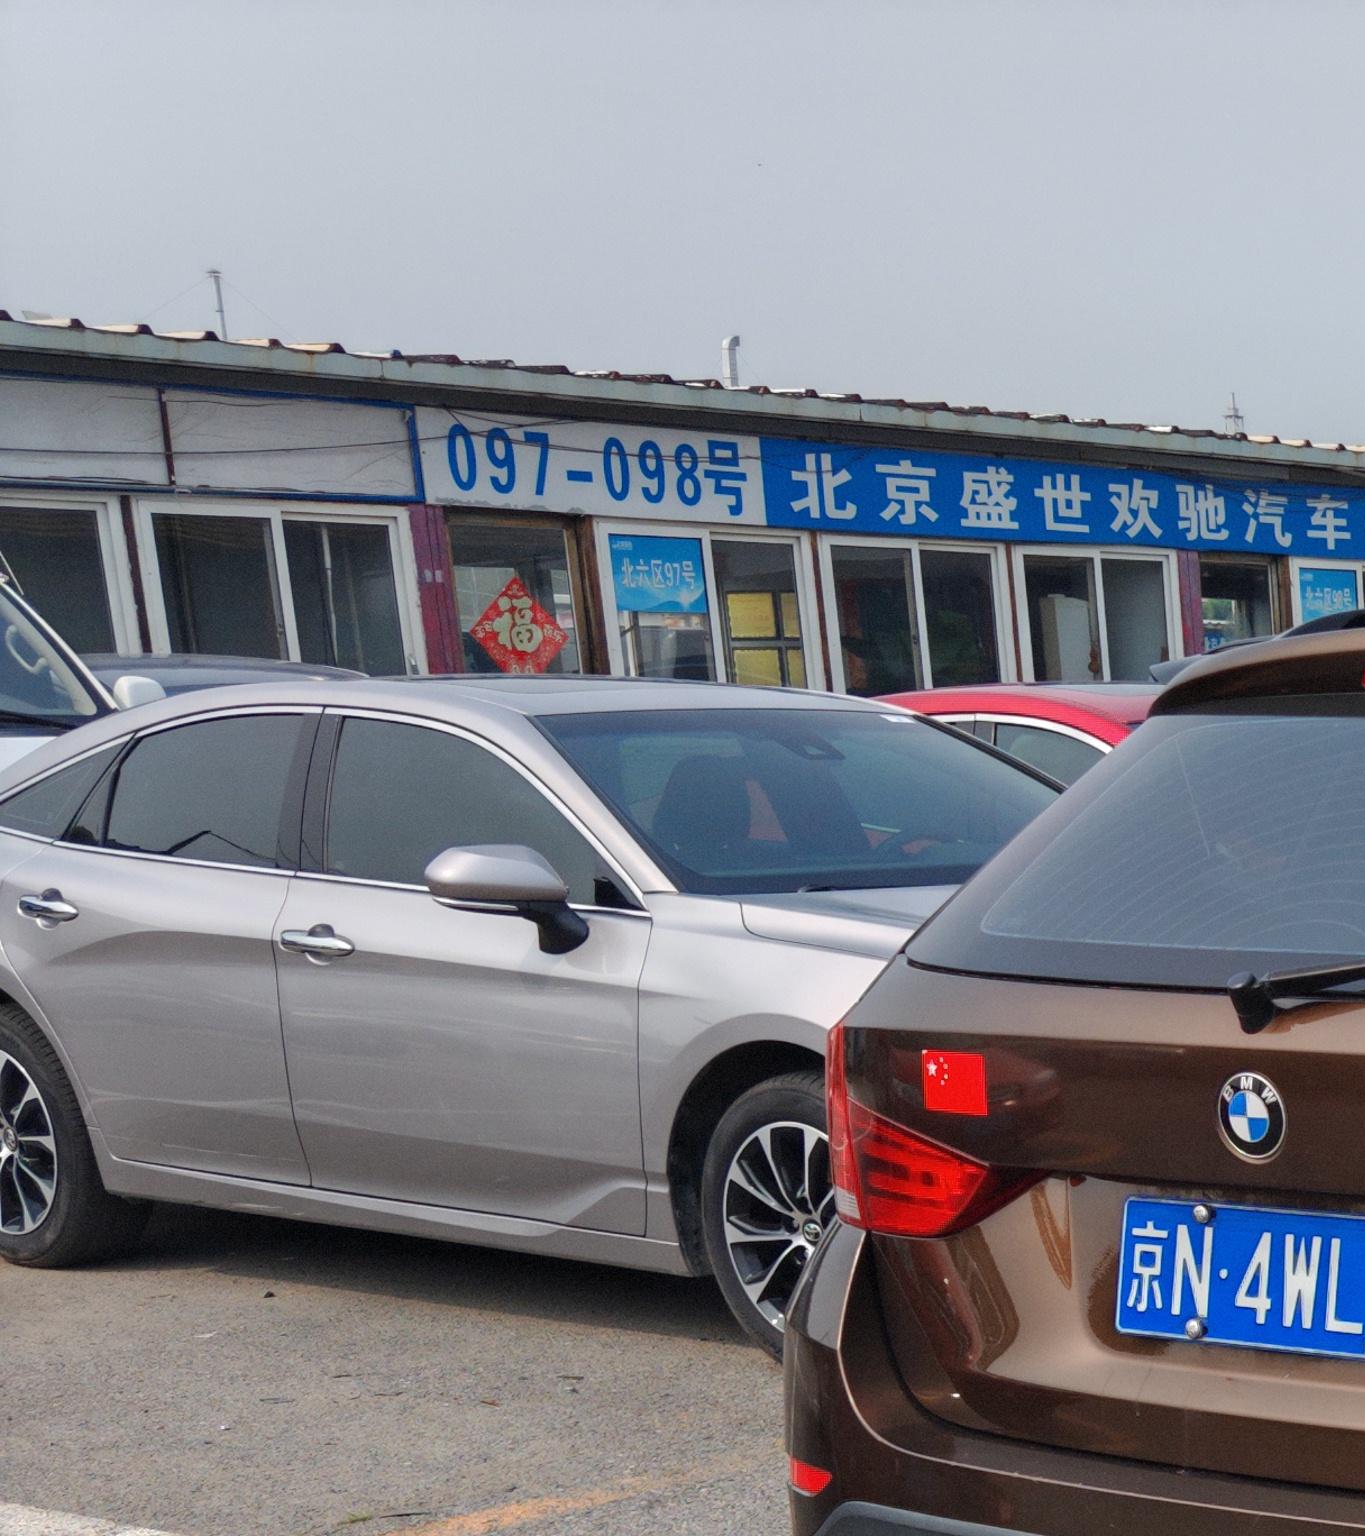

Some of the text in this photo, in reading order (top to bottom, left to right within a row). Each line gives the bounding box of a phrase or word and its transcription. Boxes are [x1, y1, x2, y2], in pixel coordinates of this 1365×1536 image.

[447, 423, 748, 516] 097-098号
[621, 557, 696, 591] 北六区97号
[1223, 1076, 1277, 1104] BMW
